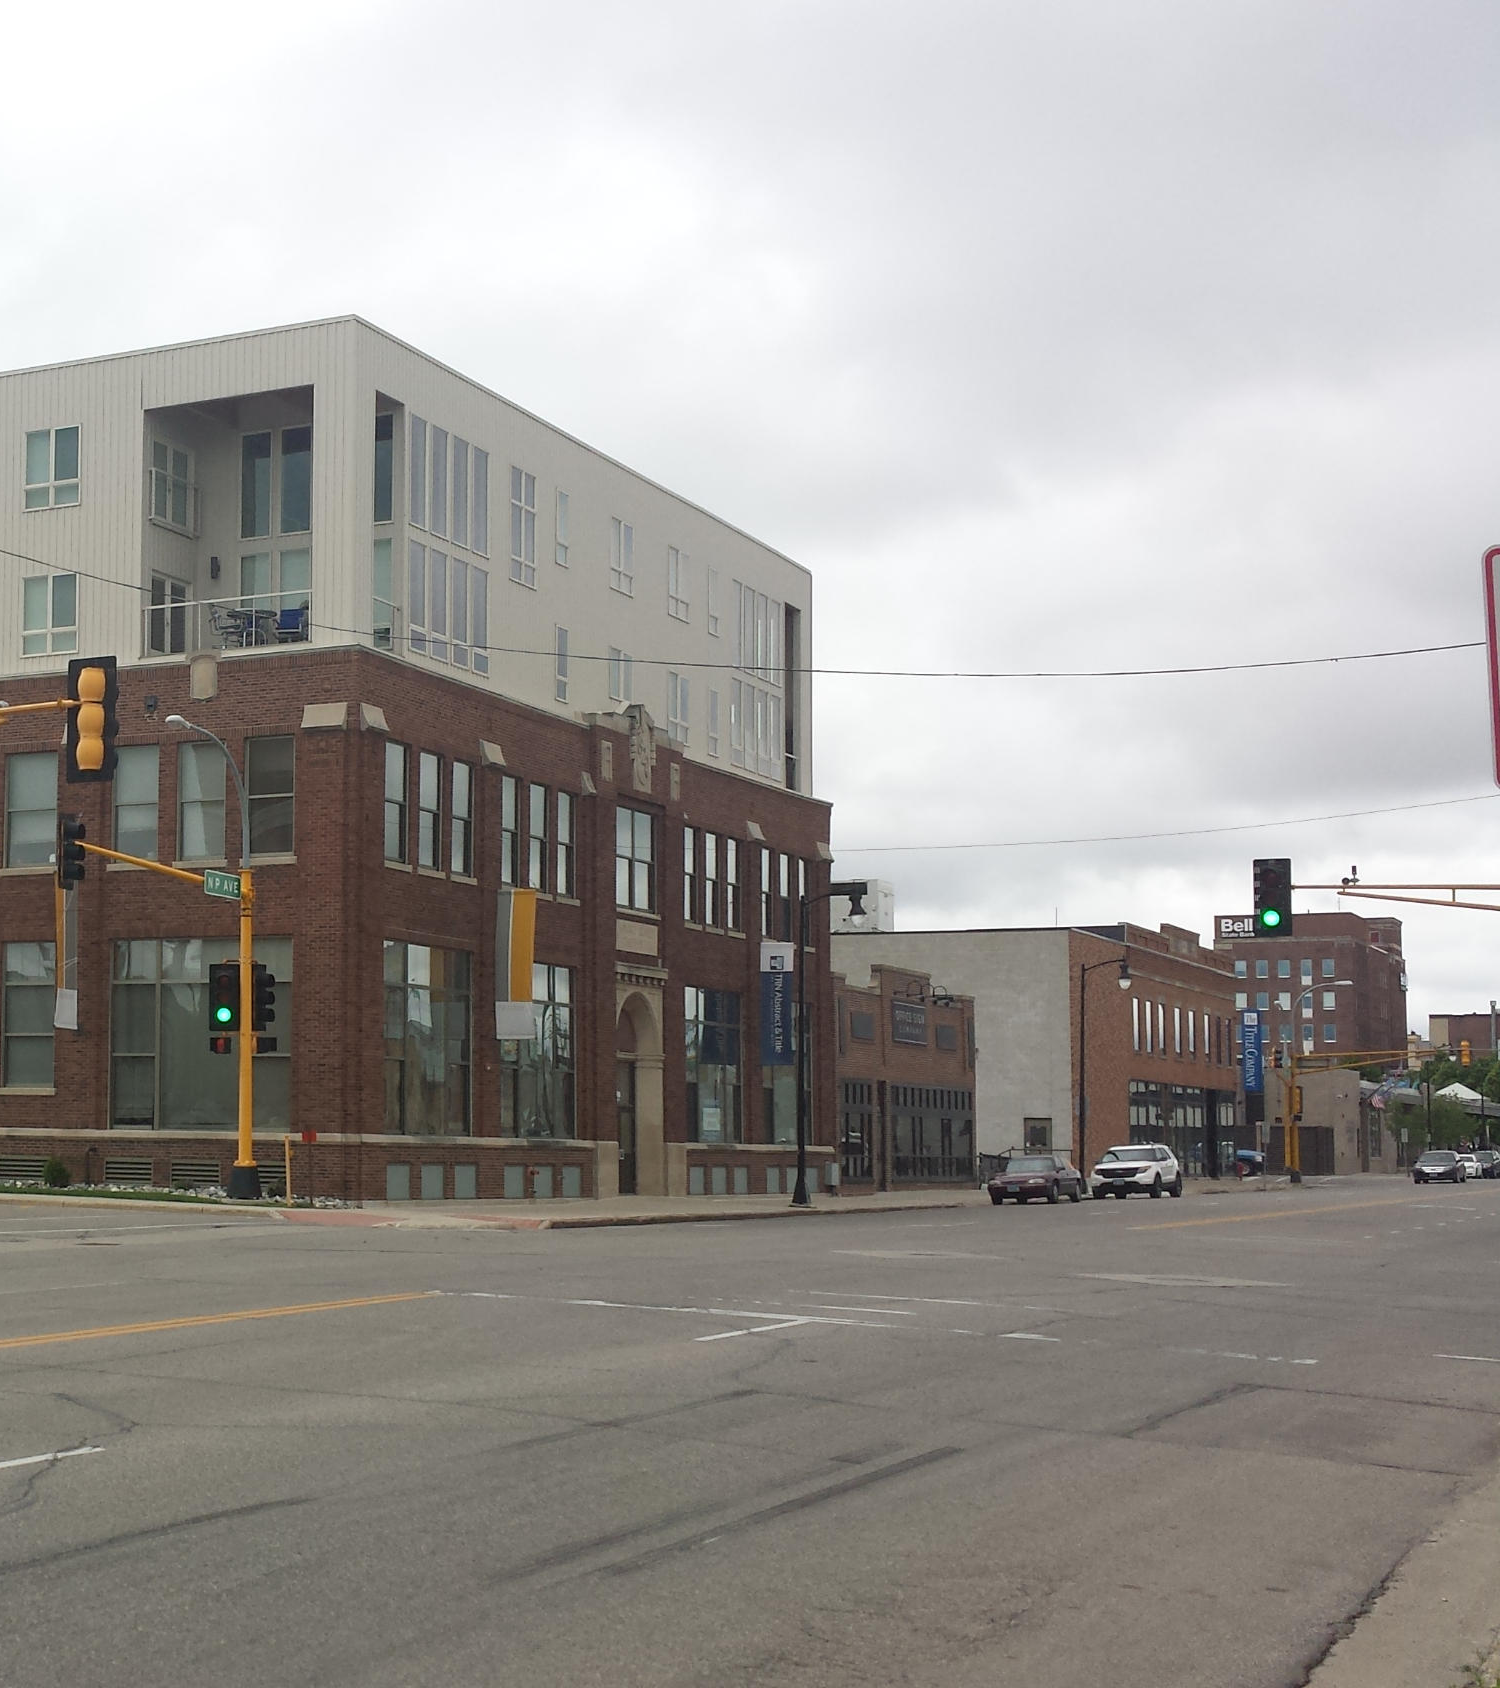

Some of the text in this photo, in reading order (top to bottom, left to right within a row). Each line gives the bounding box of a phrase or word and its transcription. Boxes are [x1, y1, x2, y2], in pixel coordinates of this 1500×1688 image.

[223, 879, 239, 894] AVE
[1220, 918, 1254, 932] Bell
[774, 991, 783, 1026] Abstract
[774, 1035, 784, 1053] Title
[1245, 1049, 1258, 1087] COMPANY
